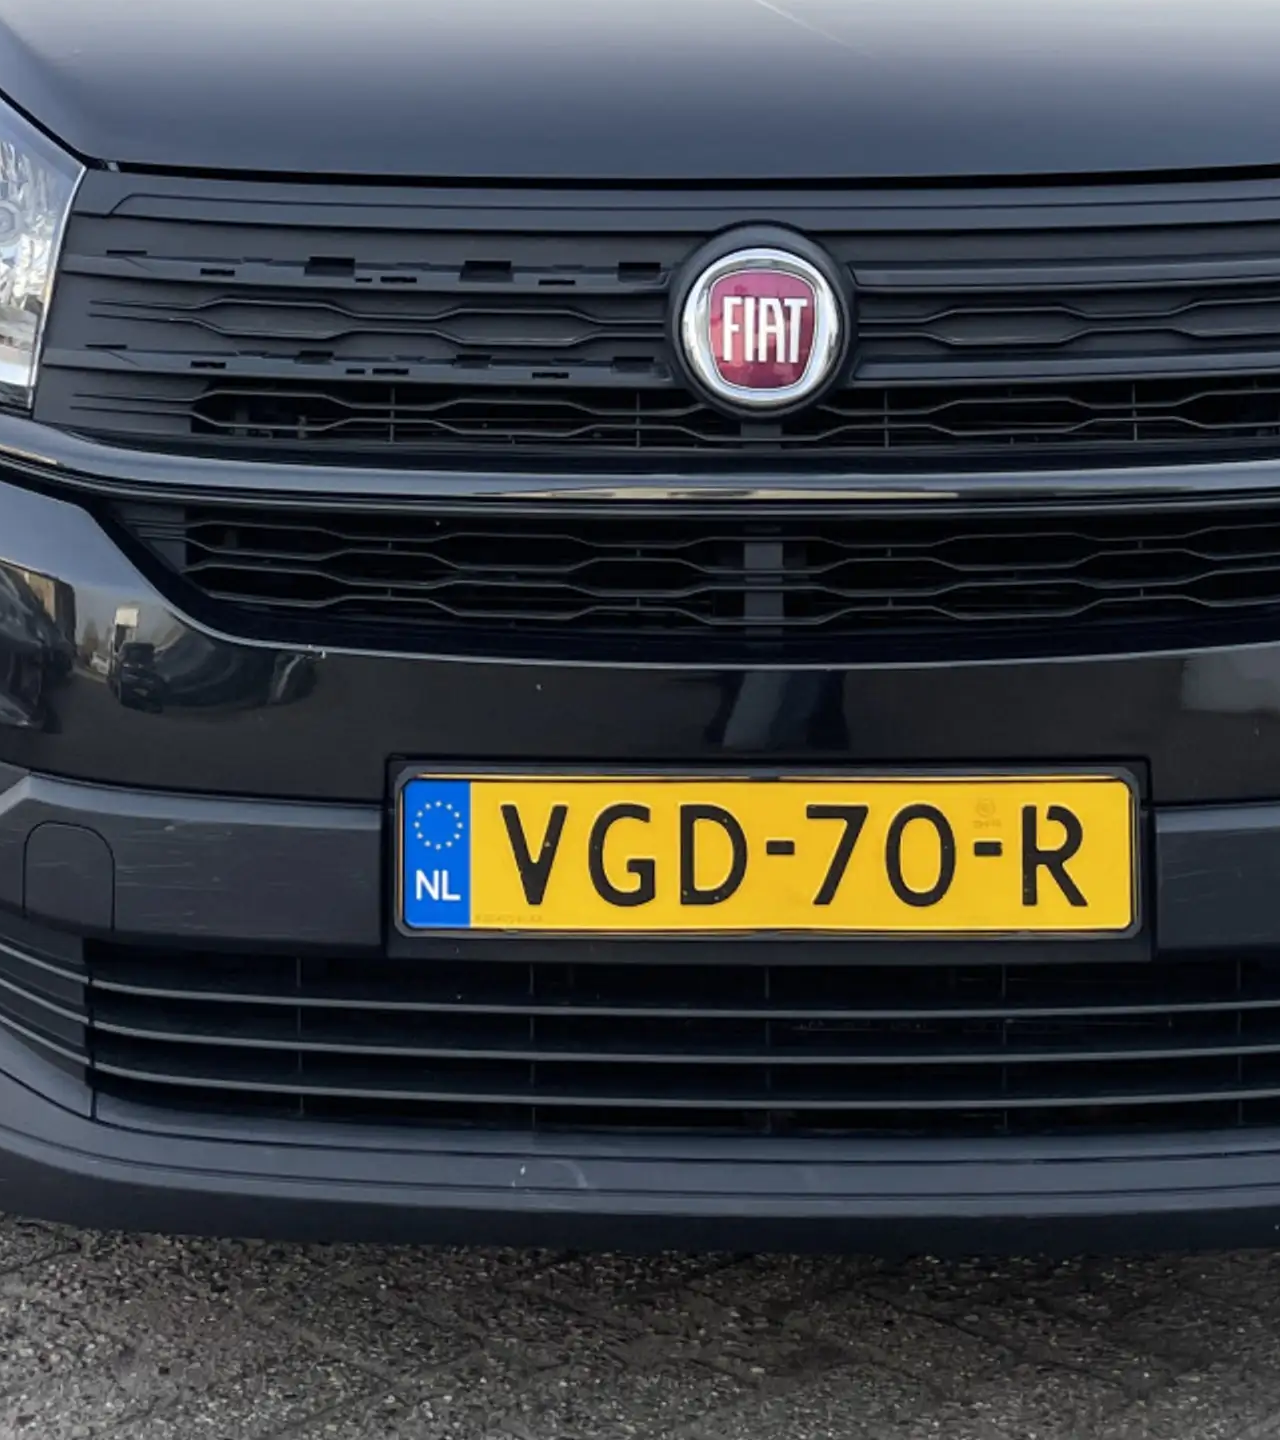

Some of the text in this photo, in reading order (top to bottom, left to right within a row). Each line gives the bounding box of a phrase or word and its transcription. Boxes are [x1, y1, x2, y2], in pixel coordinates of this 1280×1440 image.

[723, 296, 808, 364] FIAT
[415, 803, 1088, 907] NL VGD-70-R
